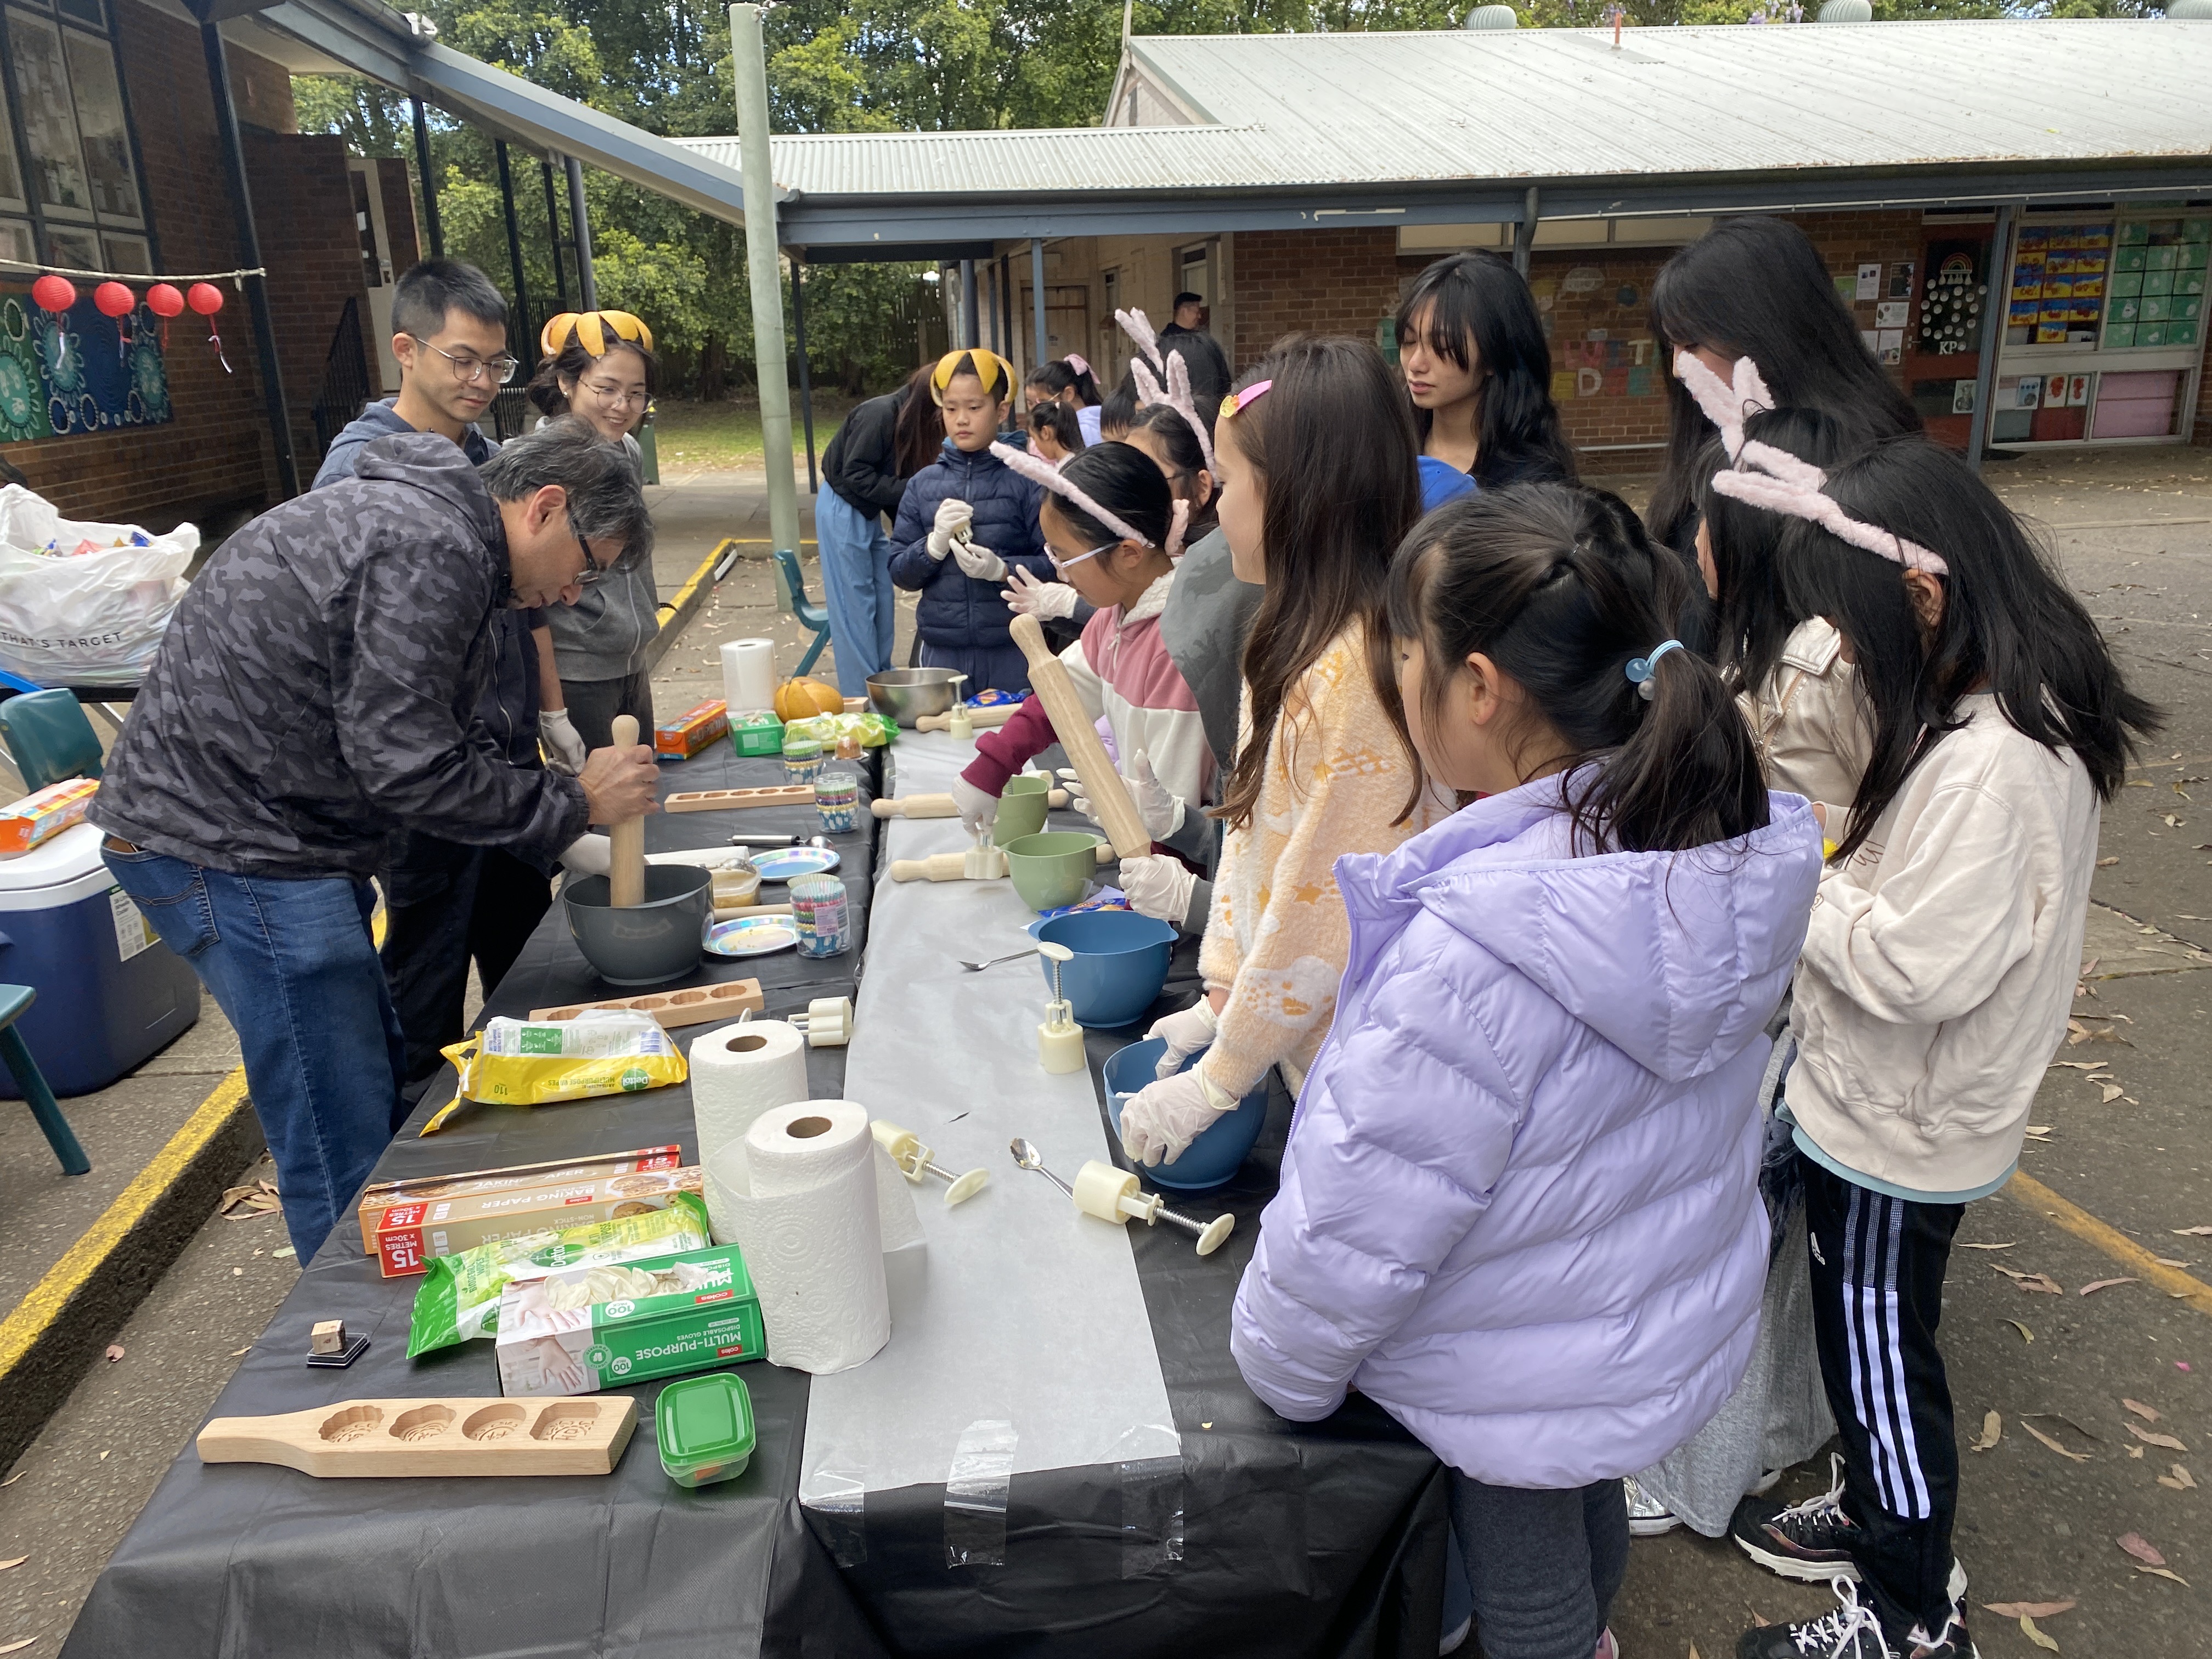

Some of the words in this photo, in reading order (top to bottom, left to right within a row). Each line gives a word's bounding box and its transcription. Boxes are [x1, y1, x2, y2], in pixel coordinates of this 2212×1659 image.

[1938, 341, 1957, 355] KP
[1, 632, 50, 648] THAT'S
[57, 632, 121, 648] TARGET
[569, 1077, 615, 1086] MULTIPURPOSE
[622, 1076, 648, 1086] Dettol
[494, 1085, 508, 1096] 110
[556, 1184, 595, 1193] NON-STICK
[537, 1188, 595, 1201] BAKING
[481, 1196, 531, 1209] PAPER
[390, 1215, 415, 1226] 15
[554, 1214, 594, 1224] NON-STICK
[385, 1241, 417, 1251] METRES
[392, 1249, 419, 1269] 15
[476, 1257, 485, 1276] WIPES
[701, 1292, 728, 1301] coles
[607, 1306, 633, 1315] 100
[703, 1324, 740, 1336] DISPOSABLE
[676, 1332, 702, 1341] GLOVES
[586, 1345, 609, 1355] POWDERED
[635, 1331, 742, 1361] MULTI-PURPOSE
[613, 1362, 630, 1372] 100
